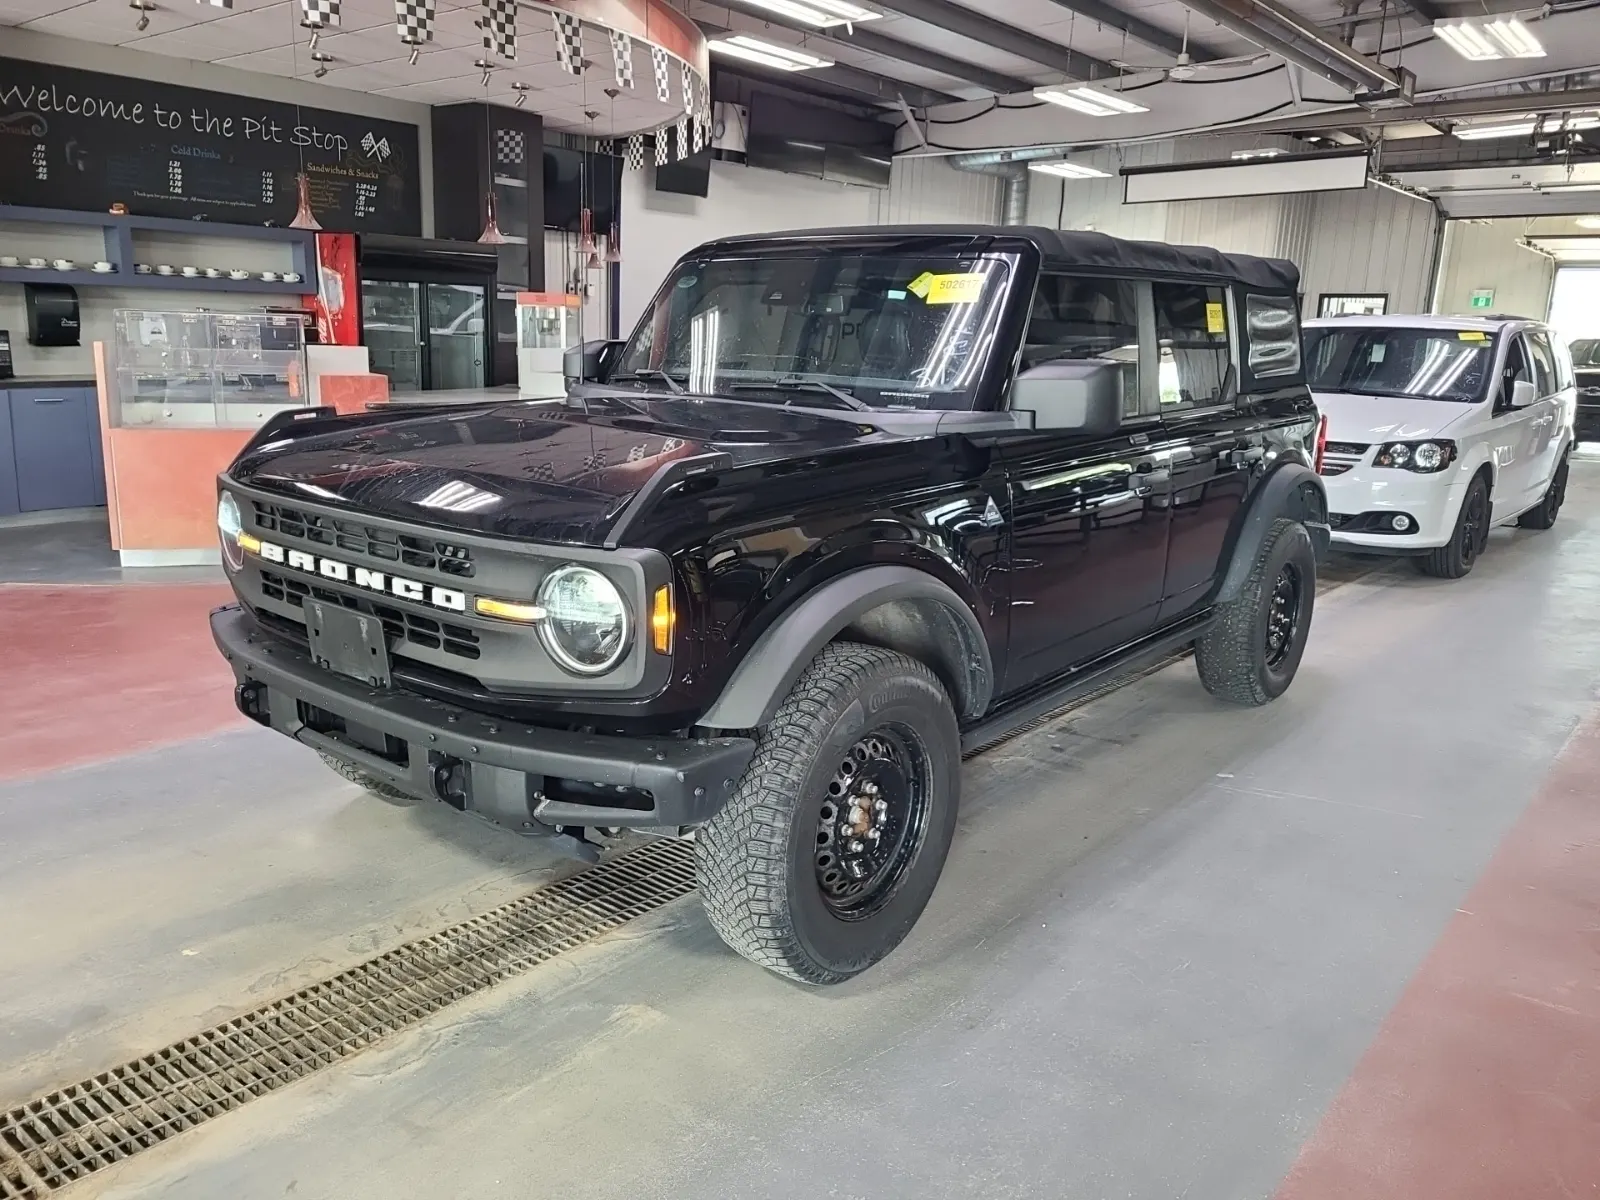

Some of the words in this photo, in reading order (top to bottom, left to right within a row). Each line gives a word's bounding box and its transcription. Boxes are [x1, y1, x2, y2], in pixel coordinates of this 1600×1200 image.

[0, 84, 145, 124] Welcome
[154, 103, 182, 129] to
[191, 108, 234, 137] the
[242, 116, 282, 143] Pit
[290, 126, 348, 161] Stop
[307, 162, 347, 176] Sandwiches
[347, 168, 356, 176] &
[356, 168, 379, 180] Snacks
[260, 541, 466, 611] BRONCO
